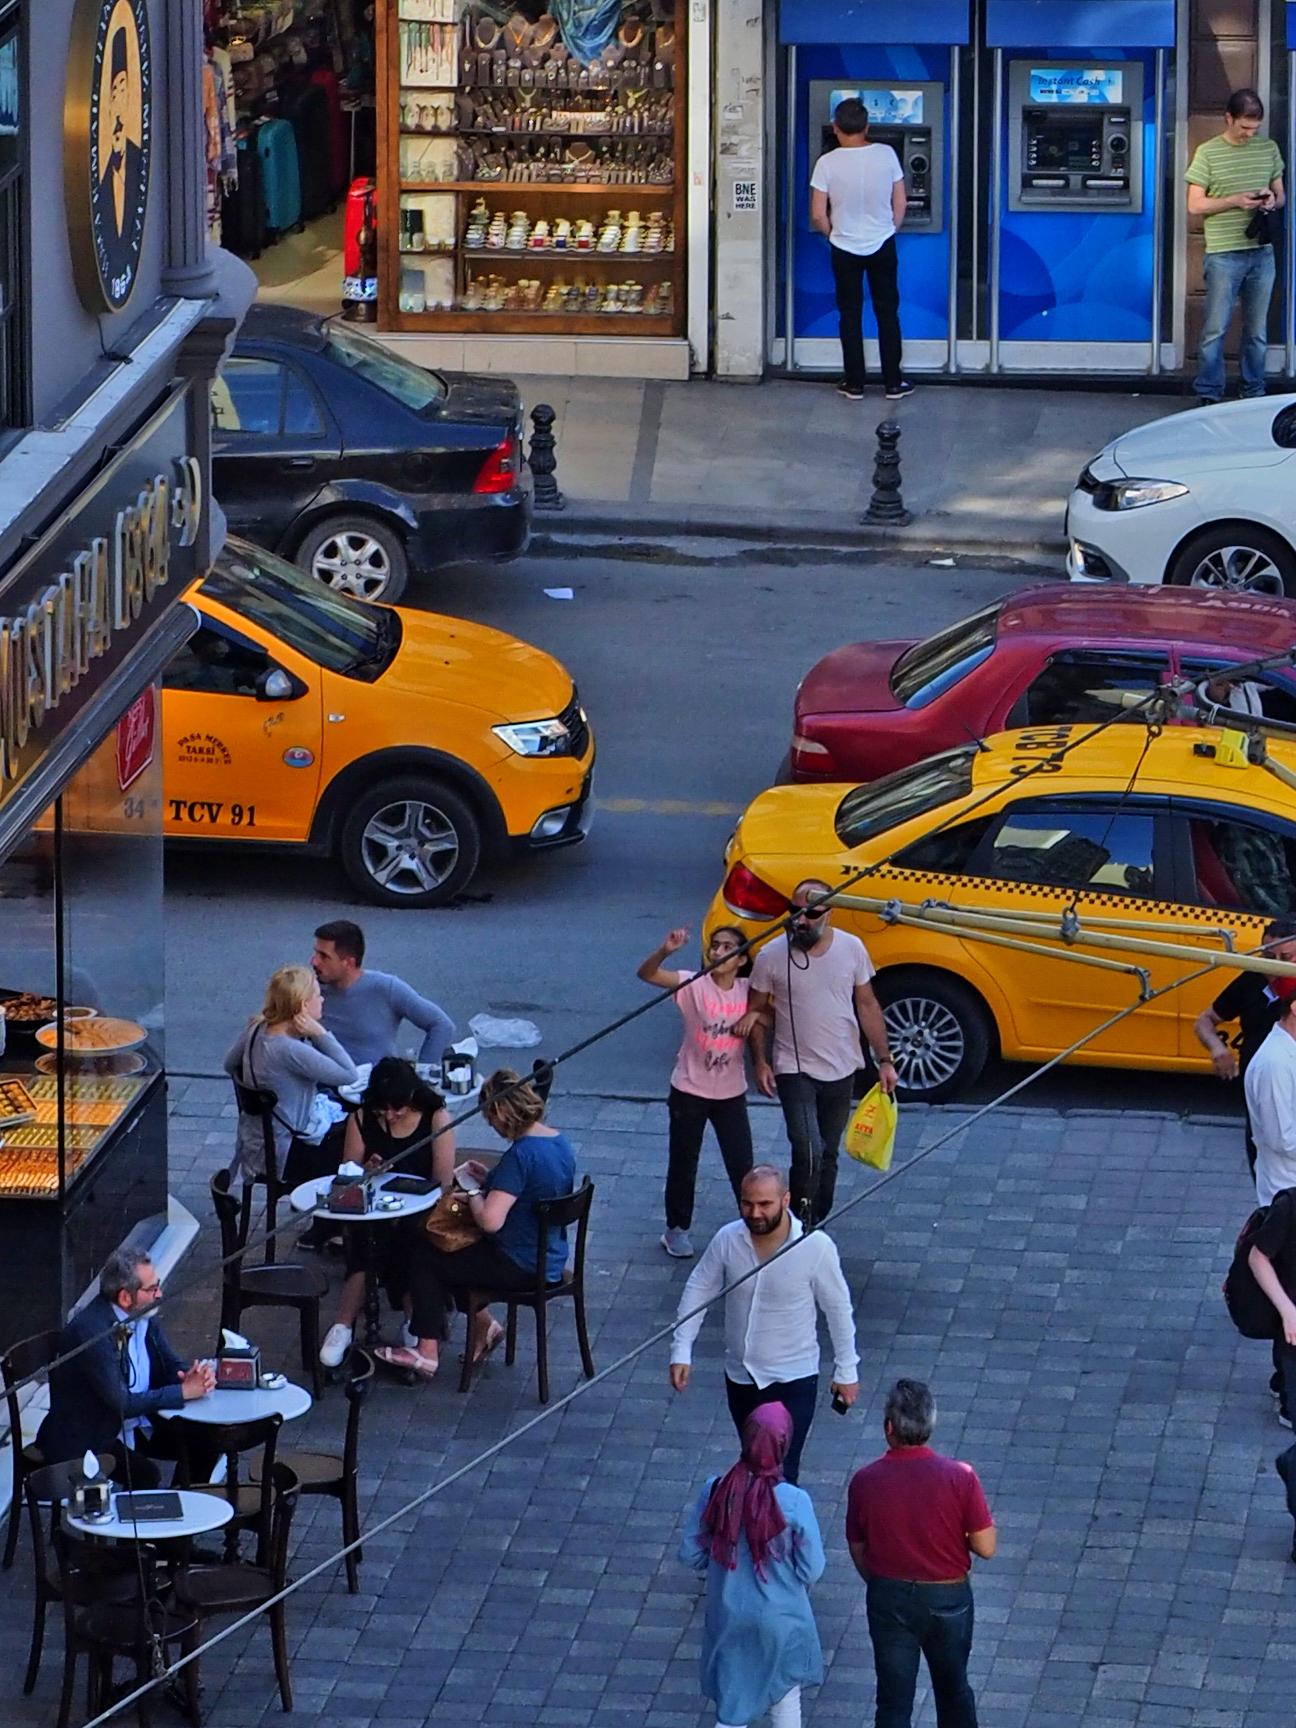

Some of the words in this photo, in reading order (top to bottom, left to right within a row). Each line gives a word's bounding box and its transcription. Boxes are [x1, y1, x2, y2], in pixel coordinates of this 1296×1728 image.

[735, 183, 756, 195] BNE
[123, 796, 146, 819] 34
[169, 799, 227, 824] TCV
[231, 803, 257, 827] 91
